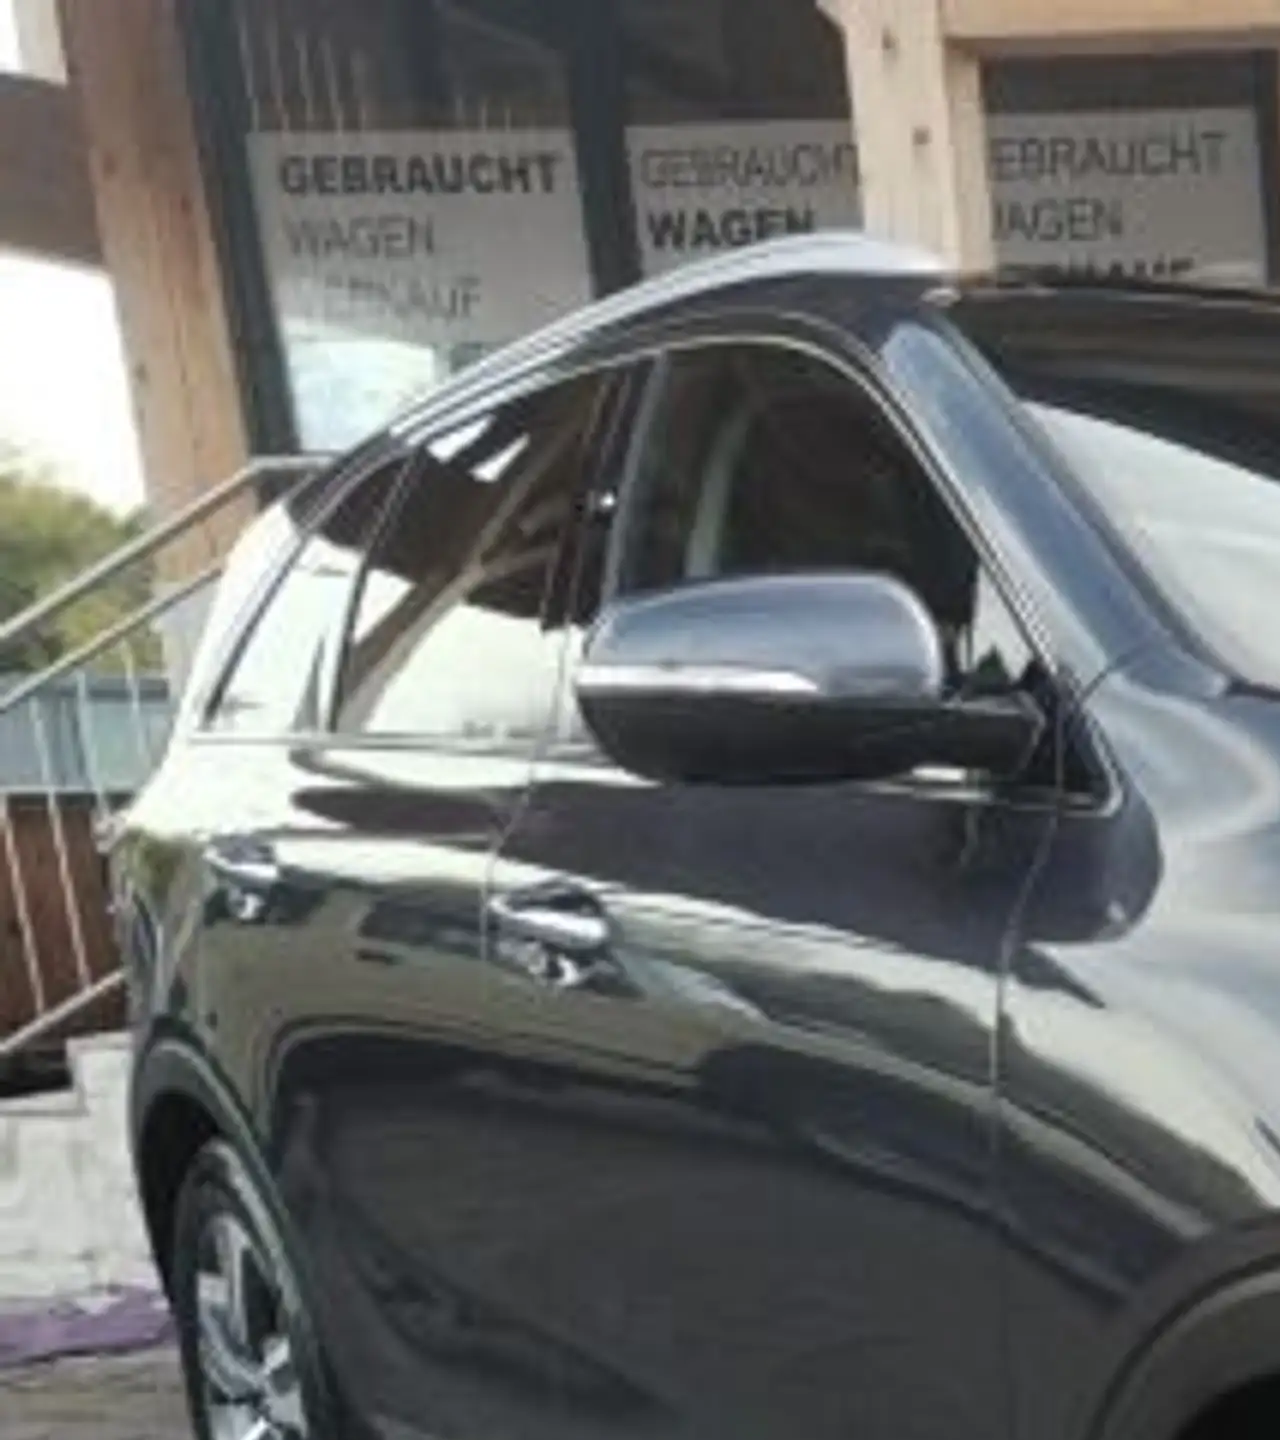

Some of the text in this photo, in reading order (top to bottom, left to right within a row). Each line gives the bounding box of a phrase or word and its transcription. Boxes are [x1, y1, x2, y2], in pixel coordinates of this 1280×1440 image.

[281, 153, 560, 195] GEBRAUCHT
[990, 130, 1227, 180] EBRAUCHT
[285, 216, 433, 258] WAGEN
[648, 205, 814, 247] WAGEN
[994, 197, 1123, 242] AGEN
